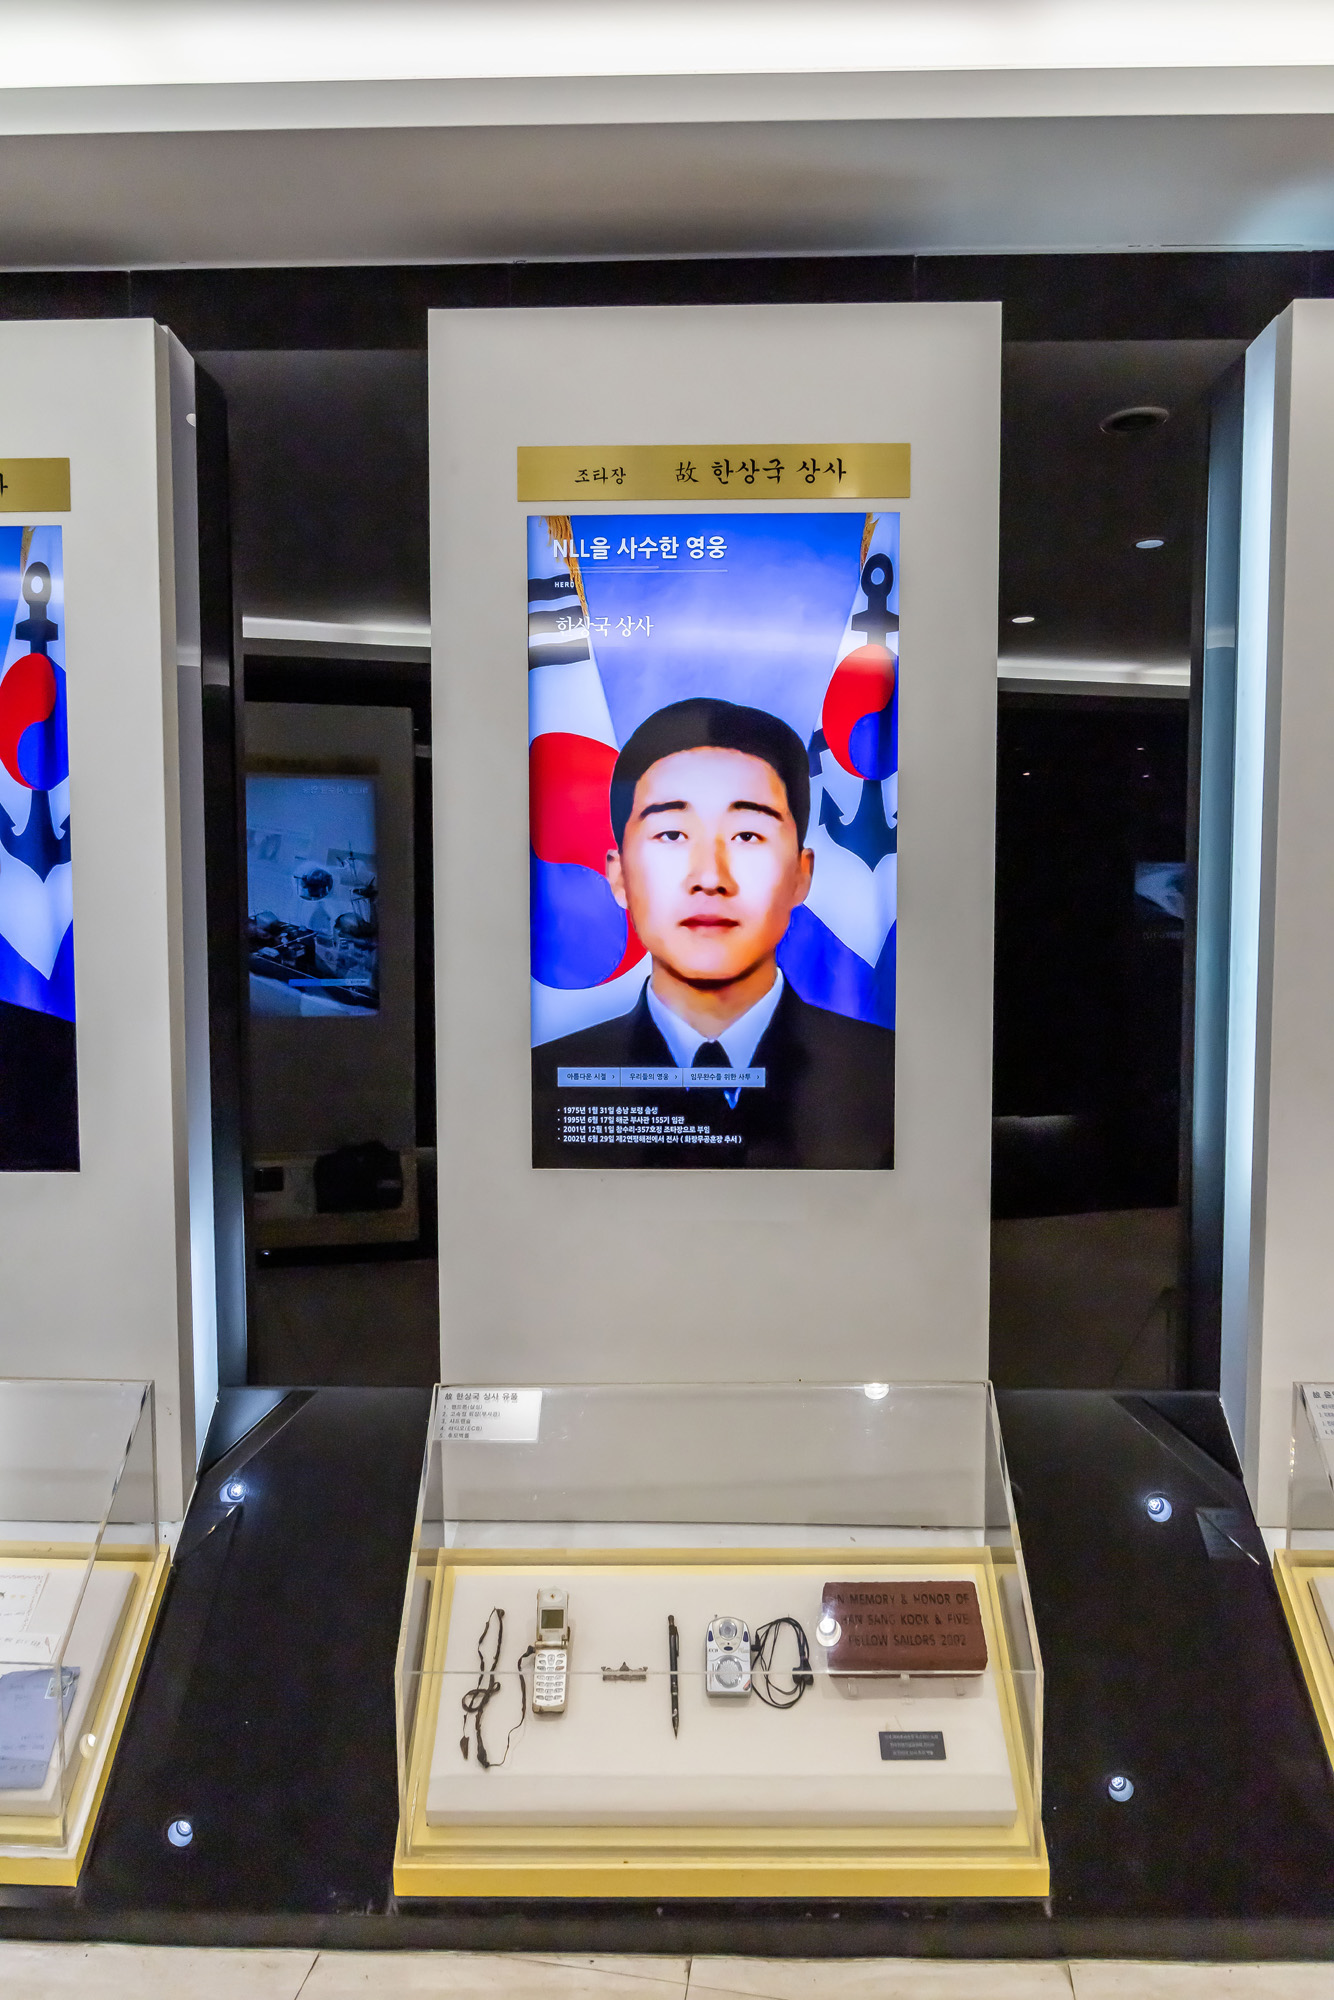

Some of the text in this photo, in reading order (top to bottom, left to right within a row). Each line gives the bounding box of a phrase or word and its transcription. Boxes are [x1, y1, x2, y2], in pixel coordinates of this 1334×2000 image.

[574, 457, 847, 485] 조타장 故 한상국 상사
[553, 535, 728, 560] NLL을 사수한 영웅
[555, 615, 655, 638] 한상국 상사
[566, 1073, 607, 1081] 아름다운 시절
[629, 1073, 669, 1081] 우리들의 영웅
[690, 1073, 722, 1081] 임무완수를
[723, 1073, 737, 1081] 위한
[563, 1106, 586, 1115] 1975년
[588, 1106, 598, 1115] 1월
[599, 1106, 615, 1115] 31일
[630, 1106, 643, 1115] 보령
[563, 1116, 685, 1124] 1995년 6월 17일 해군 부사관 155기 임관
[563, 1125, 586, 1134] 2001년
[588, 1125, 603, 1134] 12월
[604, 1125, 615, 1134] 1일
[663, 1125, 696, 1134] 조타장으로
[697, 1125, 710, 1134] 부임
[563, 1135, 586, 1143] 2002년
[587, 1135, 598, 1143] 6월
[599, 1135, 615, 1143] 29일
[666, 1135, 679, 1143] 전사
[849, 1593, 895, 1605] MEMORY
[913, 1593, 951, 1605] HONOR
[955, 1593, 970, 1605] OF
[867, 1613, 896, 1626] SANG
[900, 1613, 930, 1626] KOOK
[947, 1613, 970, 1626] FIVE
[893, 1634, 936, 1646] SAILORS
